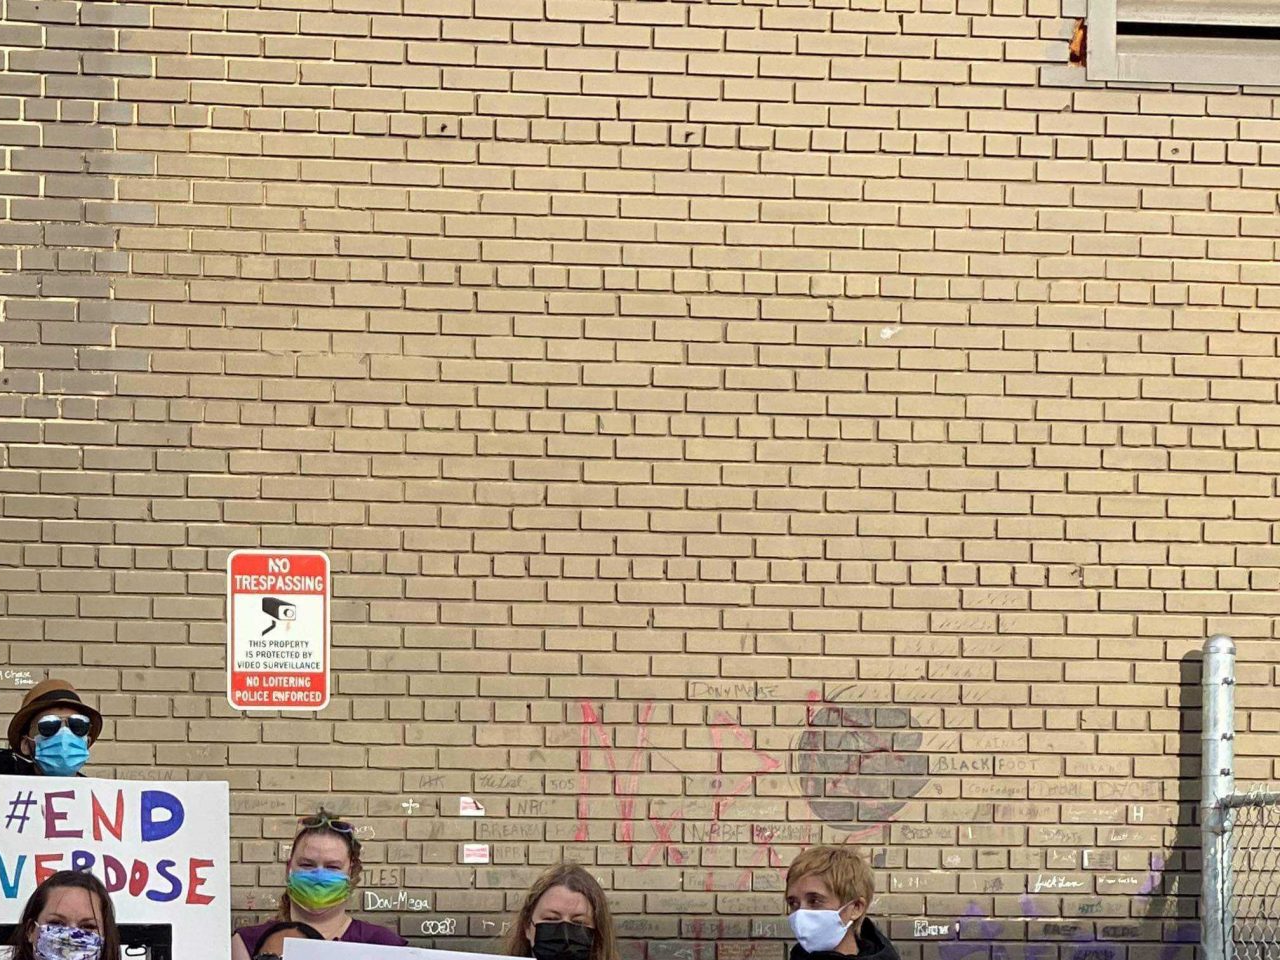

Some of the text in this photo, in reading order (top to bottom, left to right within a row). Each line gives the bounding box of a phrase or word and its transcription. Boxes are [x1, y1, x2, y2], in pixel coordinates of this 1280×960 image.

[269, 558, 290, 573] NO
[235, 575, 323, 591] TRESPASSING
[249, 640, 309, 648] THIS PROPERTY
[245, 651, 313, 659] IS PROTECTED BY
[237, 661, 321, 670] VIDEO SURVEILLANCE
[246, 676, 311, 688] NO LOITERING
[235, 690, 322, 702] POLICE ENFORCED
[5, 789, 185, 842] #END
